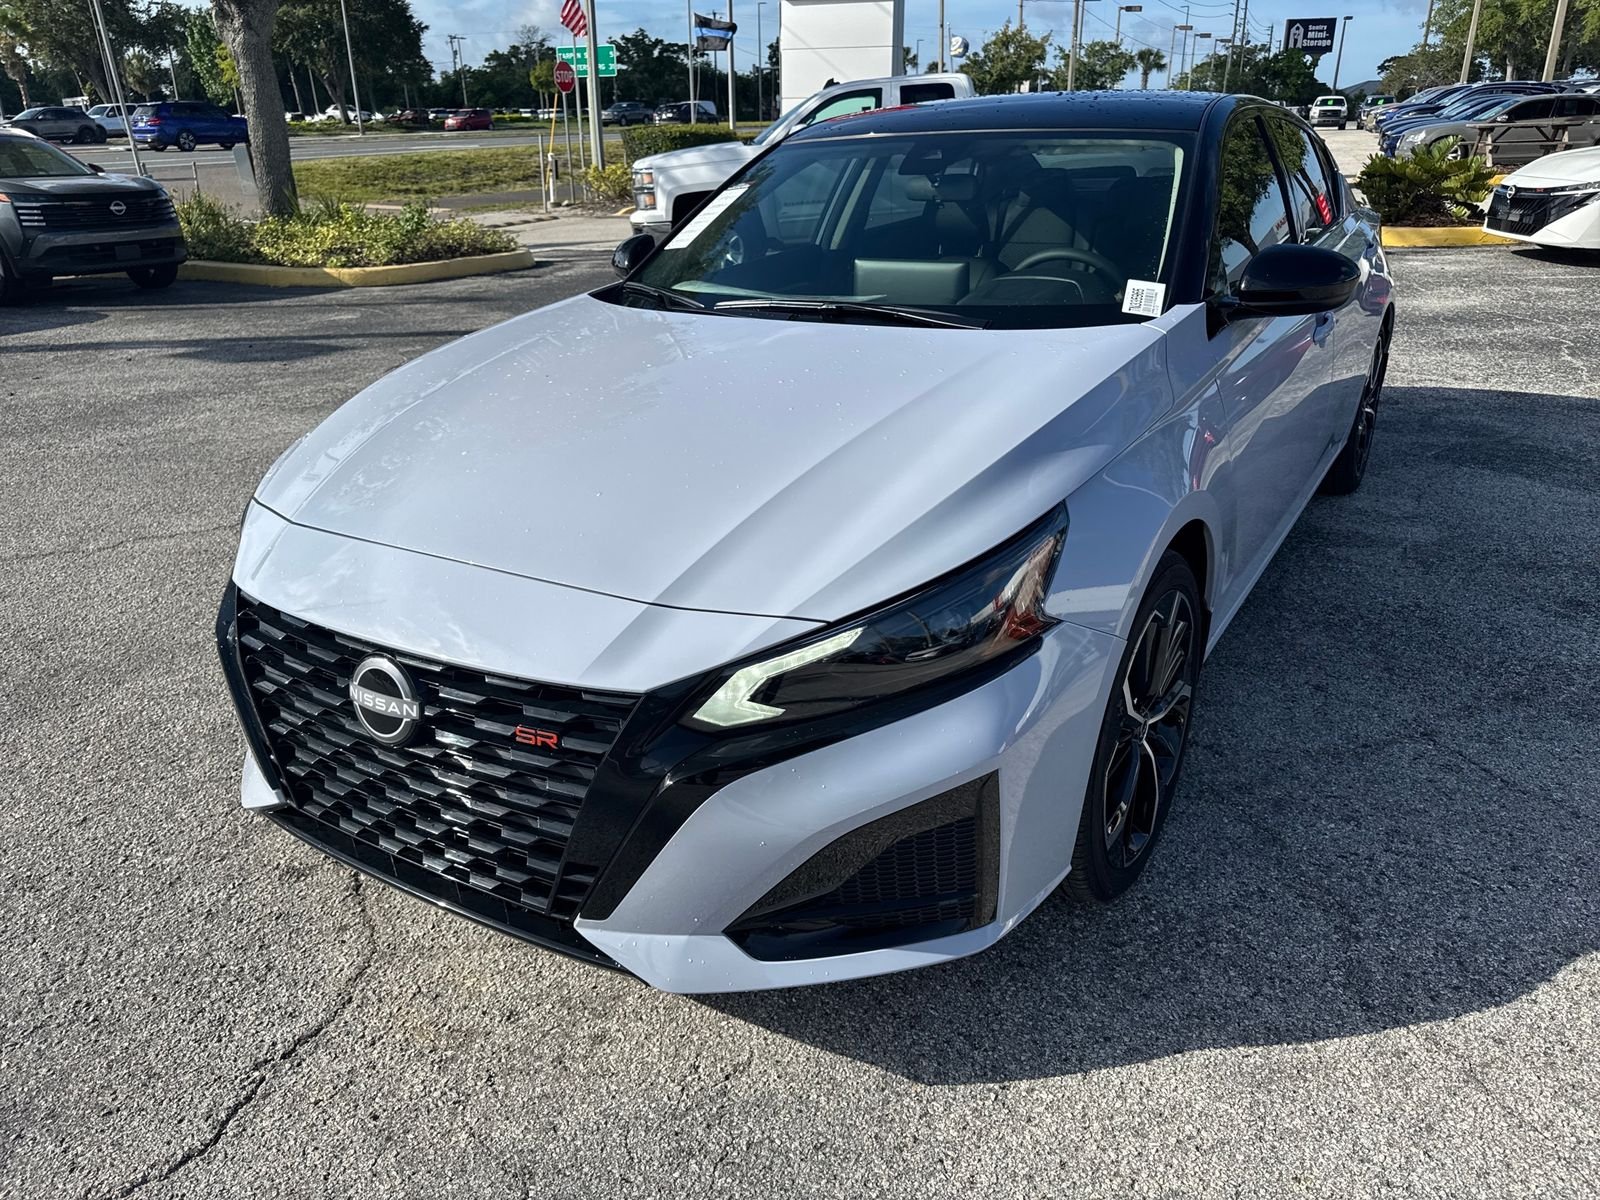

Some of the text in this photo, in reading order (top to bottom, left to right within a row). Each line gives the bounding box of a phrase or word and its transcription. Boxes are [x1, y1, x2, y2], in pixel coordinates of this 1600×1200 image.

[1307, 31, 1330, 39] Mini-
[1302, 39, 1332, 47] Storage
[558, 52, 582, 60] TARPN
[555, 70, 575, 83] STOP
[350, 684, 418, 718] NISSAN
[515, 724, 558, 750] SR
